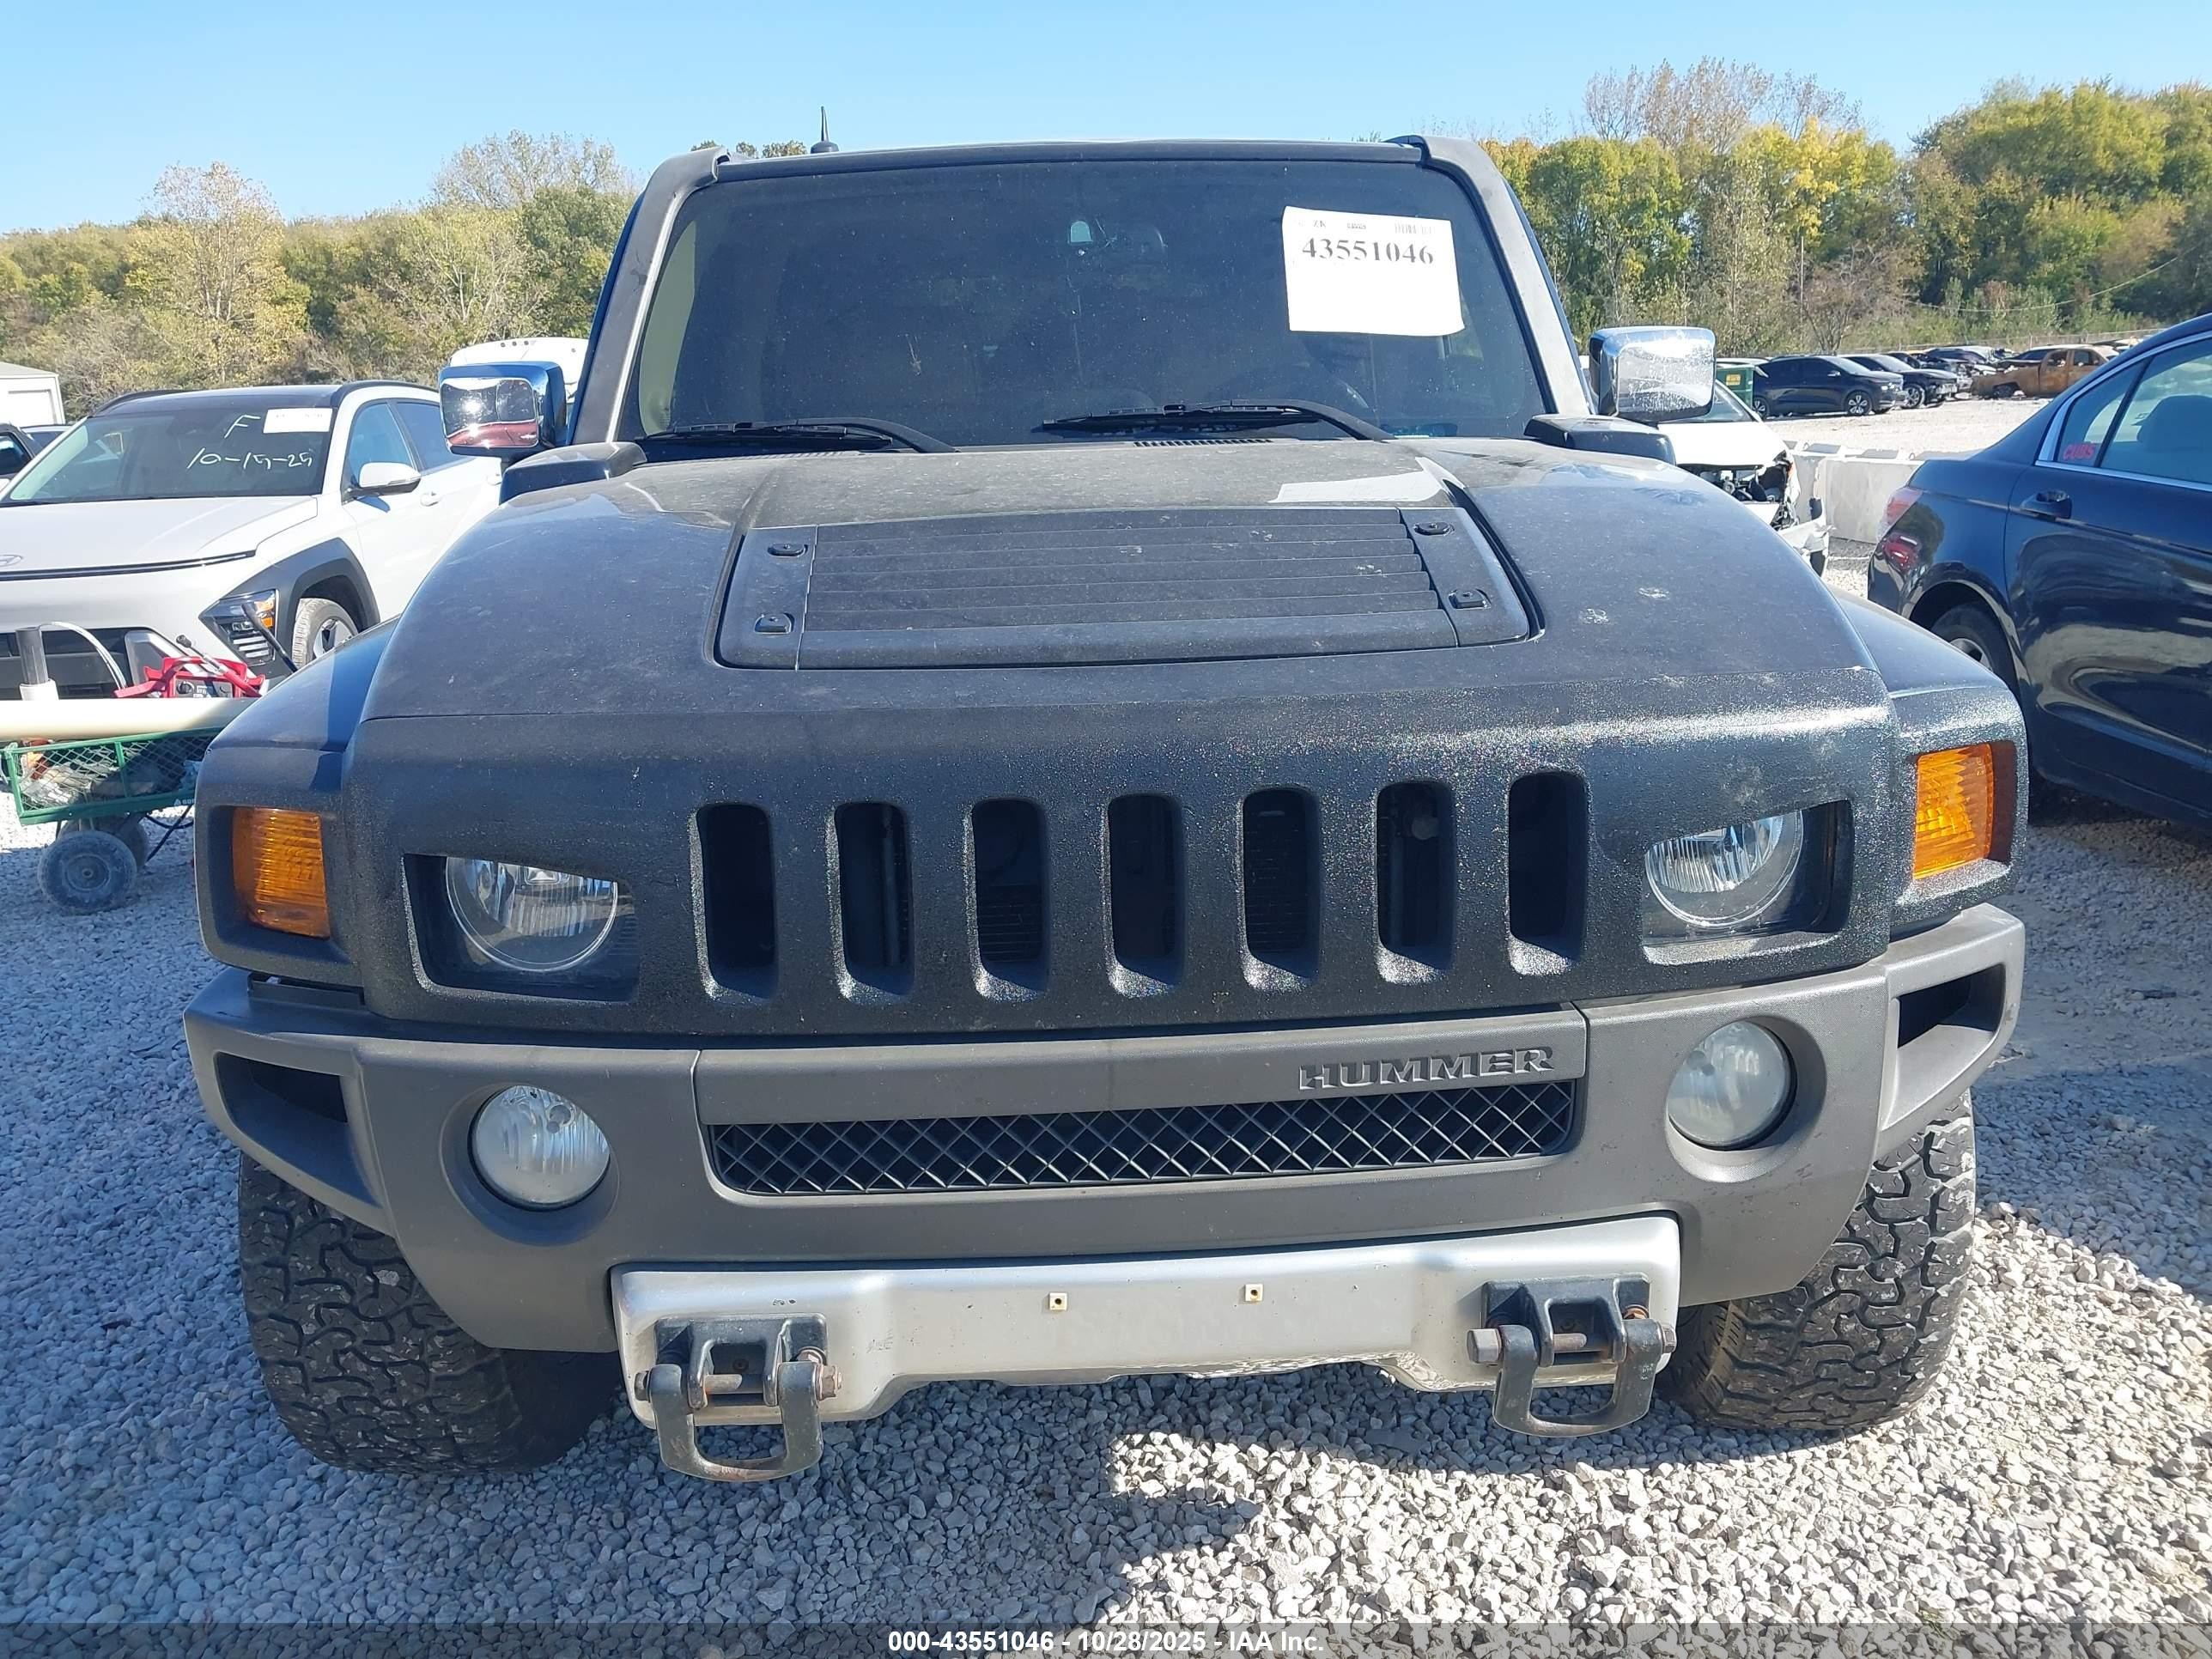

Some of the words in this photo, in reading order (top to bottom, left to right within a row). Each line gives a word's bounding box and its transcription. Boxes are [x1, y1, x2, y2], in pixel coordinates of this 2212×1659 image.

[1301, 237, 1434, 264] 43551046
[223, 414, 261, 439] F
[1298, 1046, 1554, 1091] HUMMER
